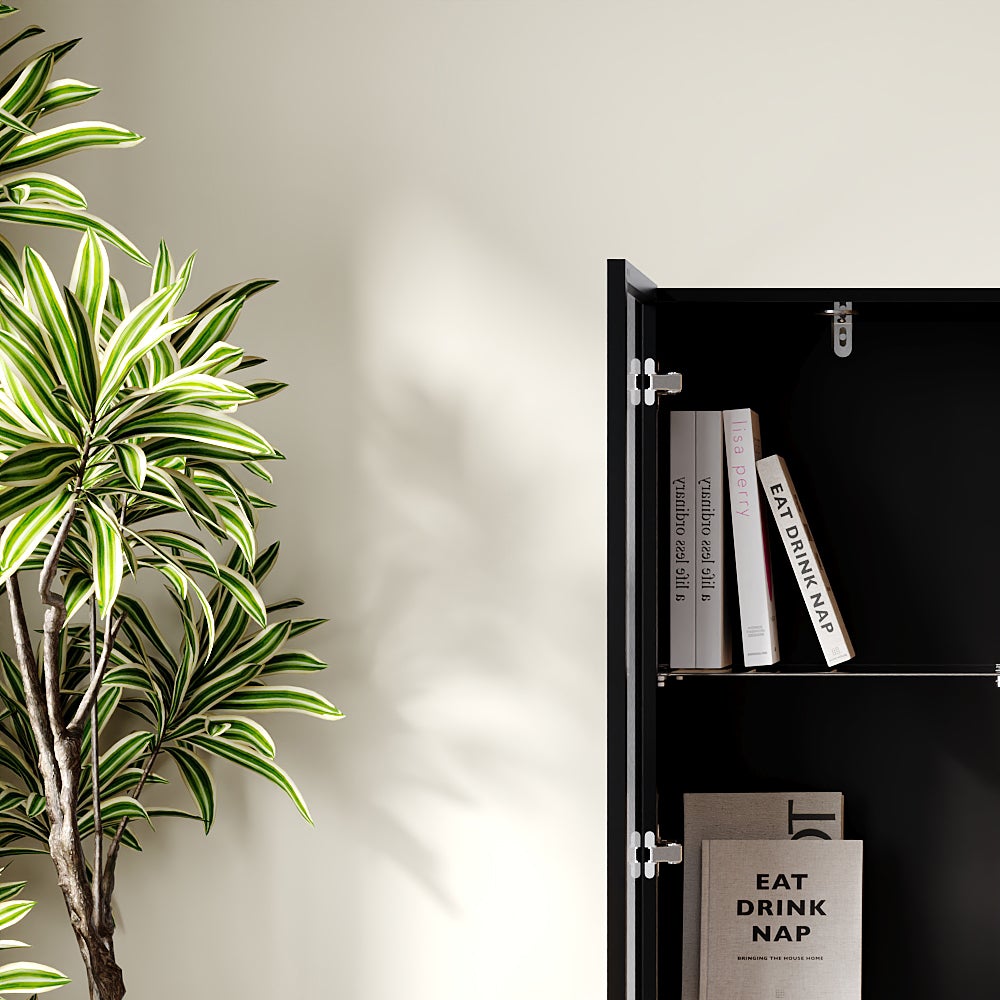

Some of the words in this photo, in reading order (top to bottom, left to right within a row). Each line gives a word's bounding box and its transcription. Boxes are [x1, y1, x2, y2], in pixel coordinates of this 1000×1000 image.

[732, 420, 748, 454] lisa
[731, 464, 750, 518] perry
[770, 483, 794, 519] EAT
[786, 525, 818, 590] DRINK
[810, 592, 834, 634] NAP
[756, 873, 808, 890] EAT
[736, 899, 827, 916] DRINK
[752, 925, 811, 942] NAP
